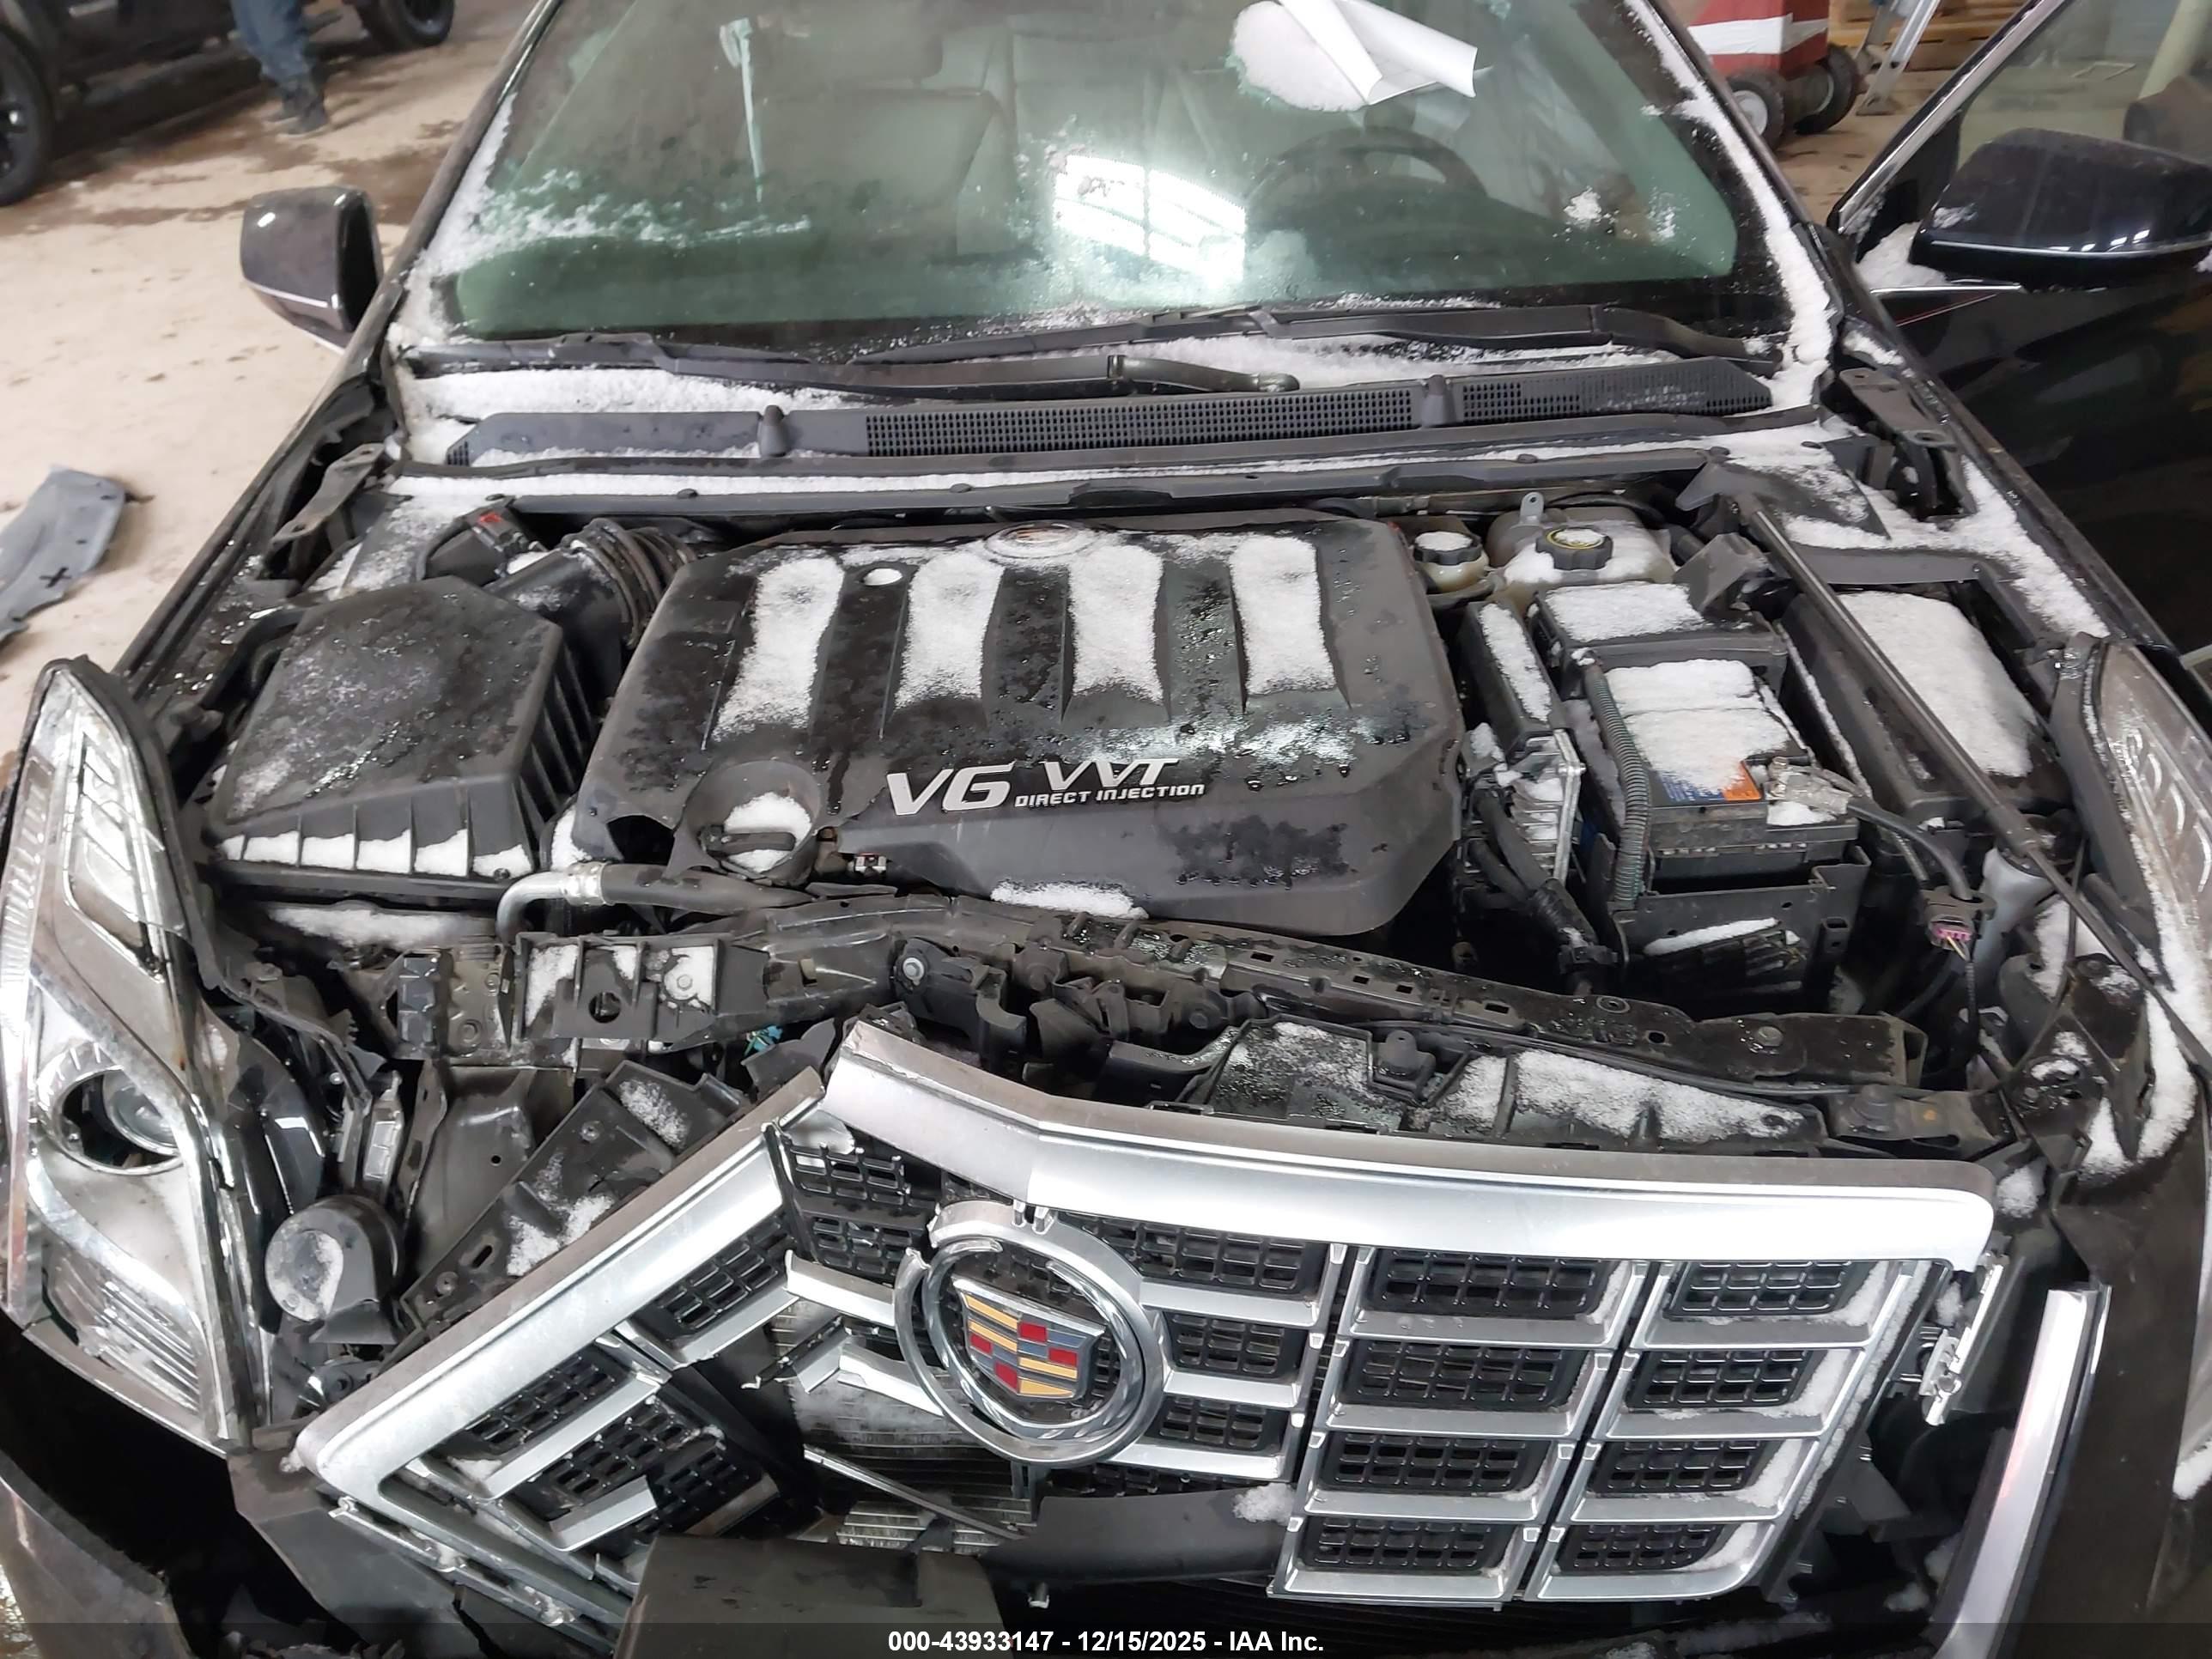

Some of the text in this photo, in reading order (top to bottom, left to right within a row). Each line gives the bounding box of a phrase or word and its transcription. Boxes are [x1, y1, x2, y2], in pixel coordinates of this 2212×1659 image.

[886, 758, 1179, 815] V6 VVT
[1014, 783, 1205, 808] DIRECT INJECTION
